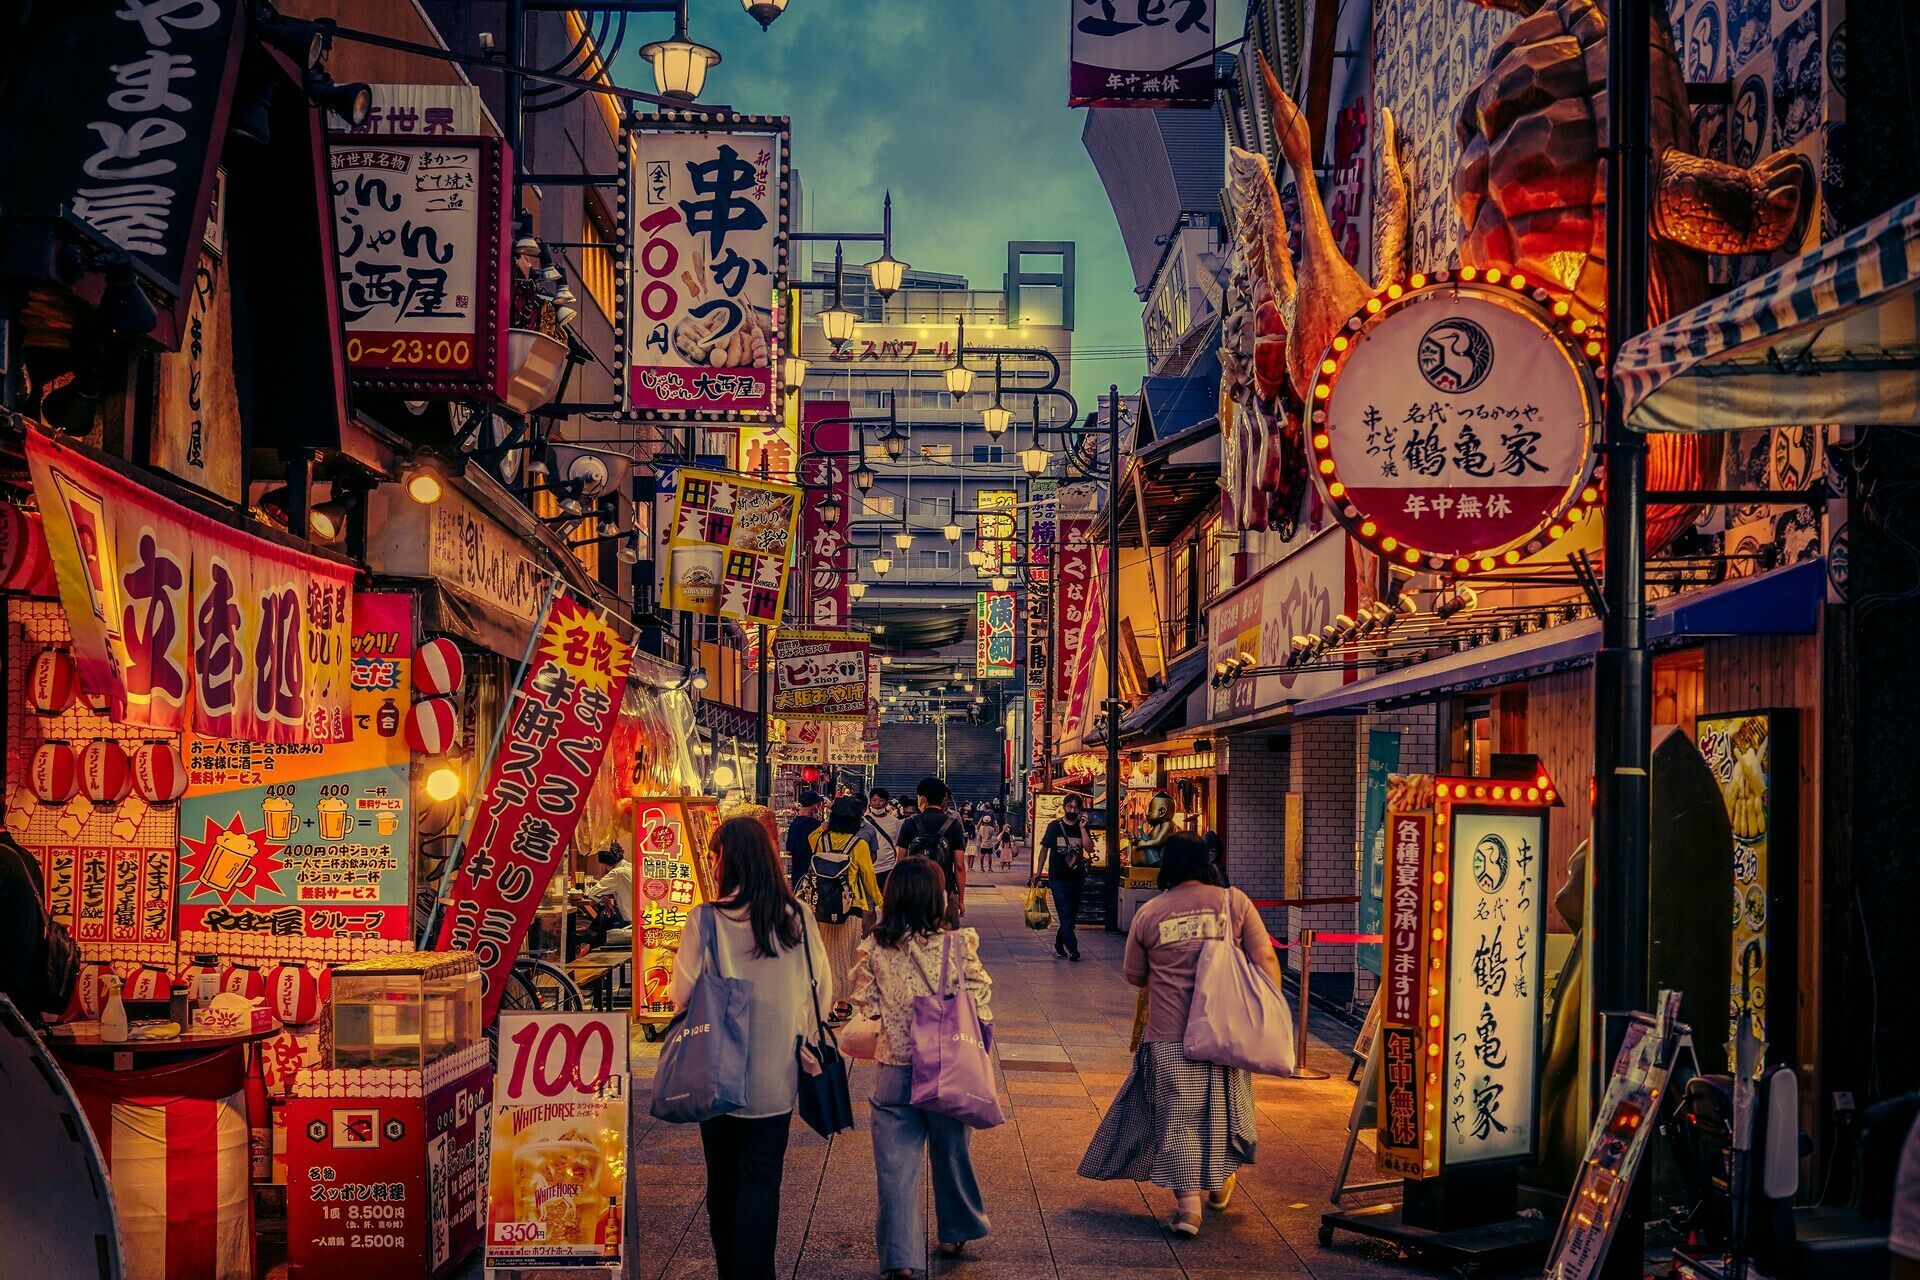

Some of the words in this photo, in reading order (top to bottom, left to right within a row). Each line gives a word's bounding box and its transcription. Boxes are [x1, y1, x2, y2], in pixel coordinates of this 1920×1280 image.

[1105, 73, 1181, 94] 年中無休
[418, 150, 469, 167] 串かつ
[415, 172, 474, 190] どて焼き
[649, 163, 668, 202] 全て
[752, 148, 773, 201] 新世界
[428, 193, 464, 209] 一品
[678, 144, 769, 347] 串かつ
[693, 373, 761, 401] 大西屋
[1403, 402, 1451, 424] 名代
[1362, 404, 1383, 458] 串かつ
[1380, 425, 1400, 477] どて焼
[1402, 423, 1550, 477] 鶴亀家
[737, 491, 774, 511] 新世界
[1403, 493, 1513, 520] 年中無休
[740, 511, 779, 529] おやじの
[988, 595, 1014, 664] 横綱
[562, 625, 614, 675] 名物
[774, 683, 865, 710] 大阪みやげ
[190, 756, 276, 770] お客様に酒一合
[190, 771, 263, 785] 無料サービス
[266, 784, 296, 797] 400
[319, 784, 350, 797] 400
[365, 786, 388, 797] 一杯
[358, 799, 401, 810] 無料サービス
[283, 844, 391, 857] 400円の中ジョッキ
[283, 858, 398, 869] お一人で二杯お飲みの方に
[642, 856, 692, 879] 時間営業
[296, 871, 381, 884] 小ジョッキ一杯
[1516, 837, 1535, 914] 串かつ
[301, 885, 377, 900] 無料サービス
[310, 910, 385, 930] グループ
[1470, 925, 1508, 1141] 鶴亀家
[1387, 1031, 1416, 1145] 年中無休
[512, 1105, 543, 1132] WHITE
[543, 1102, 575, 1122] HORSE
[308, 1166, 336, 1182] 名物
[310, 1182, 406, 1202] スッポン料理
[534, 1184, 557, 1209] WHITE
[556, 1181, 580, 1198] HORSE
[348, 1205, 405, 1220] 8,500円
[350, 1234, 405, 1249] 2,500円
[532, 1246, 574, 1256] ホワイトホース
